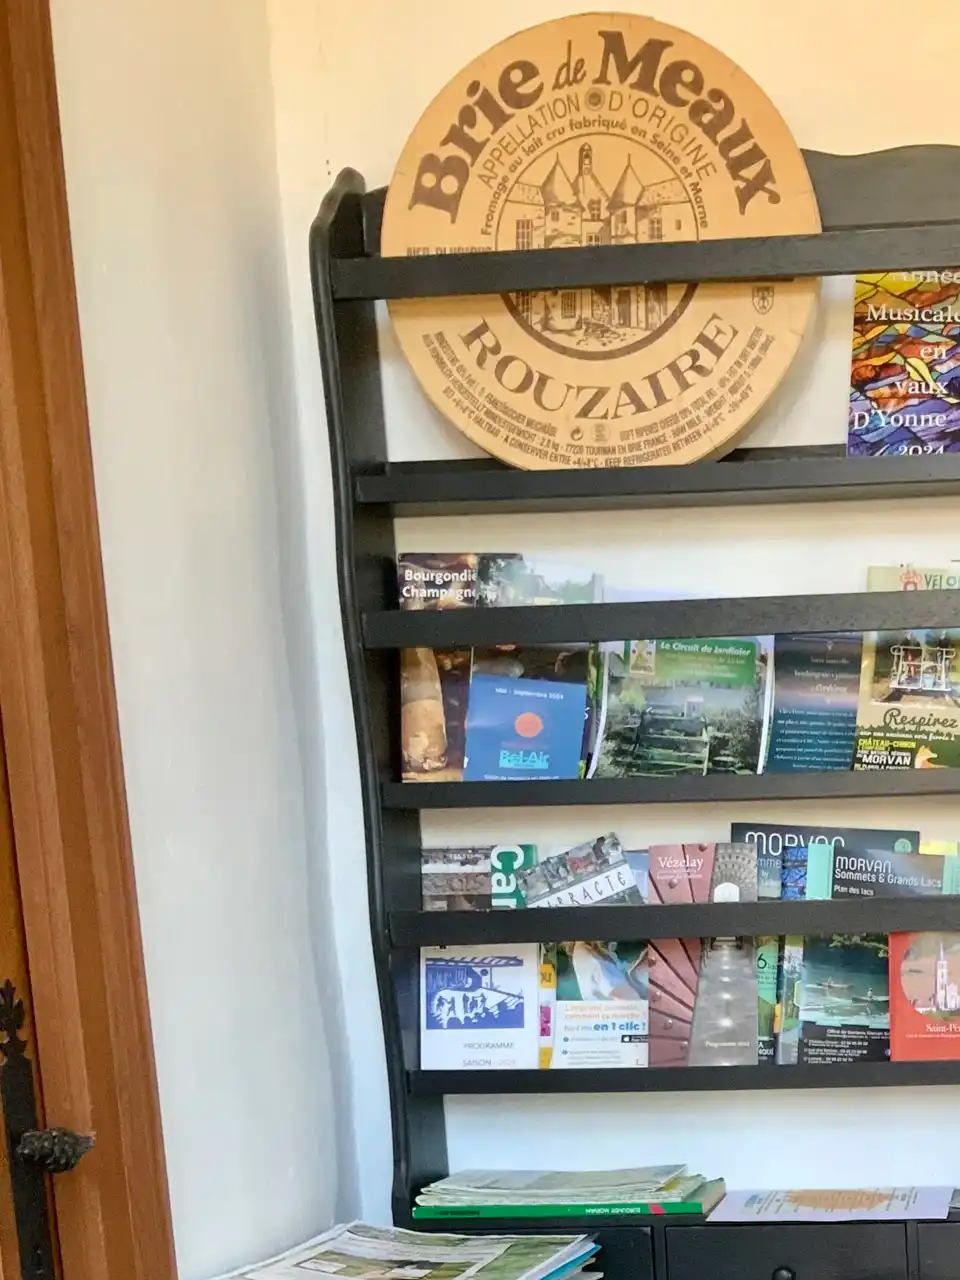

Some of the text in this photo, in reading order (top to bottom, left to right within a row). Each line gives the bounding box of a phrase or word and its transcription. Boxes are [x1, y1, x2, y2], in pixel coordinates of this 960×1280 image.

[409, 30, 781, 224] Brie de Meaux
[477, 91, 717, 189] APPELLATION D'ORIGINE
[481, 115, 709, 236] Fromage au lait cru fabriqué en Seine et Marne
[920, 346, 947, 360] en
[458, 312, 739, 421] ROUZAIRE
[895, 379, 949, 397] vaux
[854, 410, 947, 429] D'Yonne
[404, 568, 477, 585] Bourgondië
[672, 642, 699, 652] Circuit
[701, 645, 712, 653] du
[713, 646, 751, 656] Jardinier
[883, 708, 958, 731] Respirez
[500, 749, 550, 765] Bel-Air
[862, 755, 911, 766] MORVAN
[658, 855, 704, 871] Vézelay
[834, 869, 942, 888] Sommets & Grands Lacs
[834, 885, 848, 894] Plan
[861, 887, 874, 896] lacs
[593, 1023, 609, 1031] en
[618, 1021, 640, 1031] clic
[463, 1042, 515, 1050] PROGRAMME
